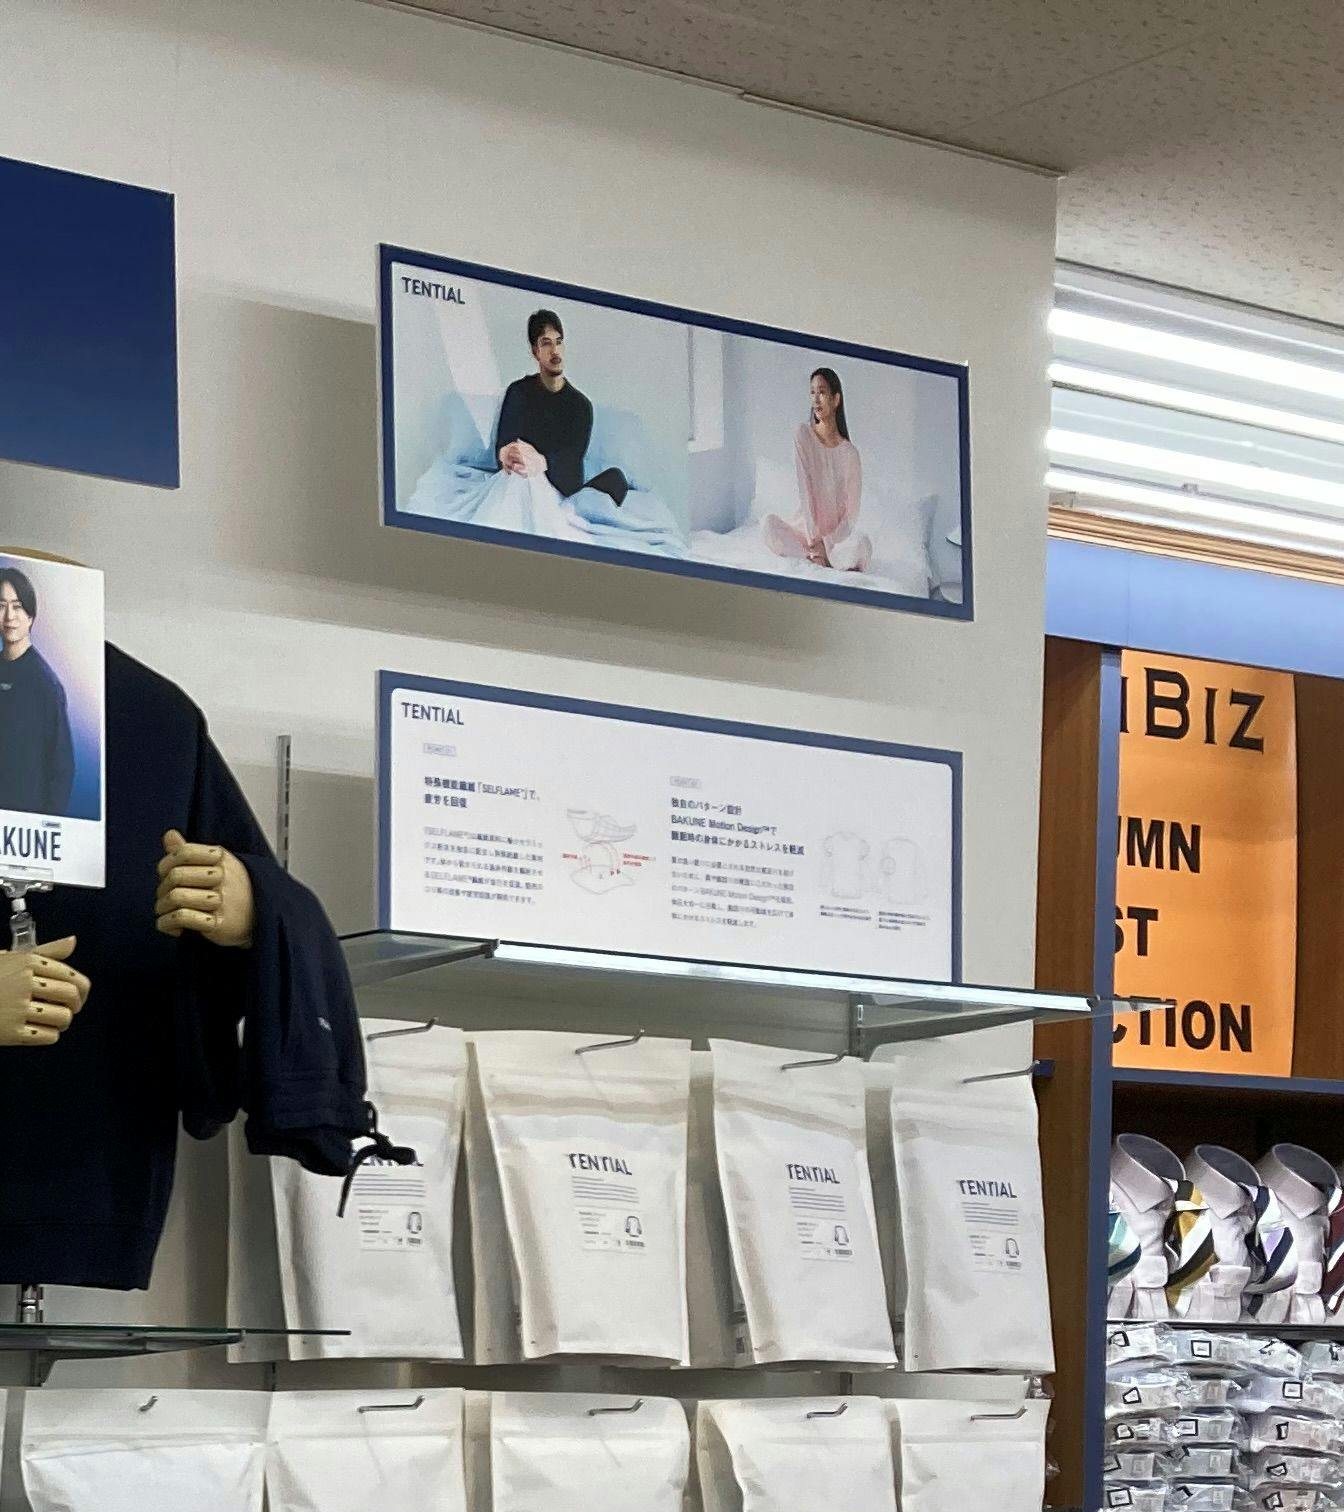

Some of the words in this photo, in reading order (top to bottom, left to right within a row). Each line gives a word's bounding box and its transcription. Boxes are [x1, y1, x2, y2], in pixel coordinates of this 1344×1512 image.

[401, 276, 465, 304] TENTIAL
[401, 702, 464, 725] TENTIAL
[1116, 815, 1201, 874] MN
[567, 1153, 633, 1176] TENTIAL
[786, 1163, 840, 1185] TENTIAL
[956, 1178, 1018, 1200] TENTIAL
